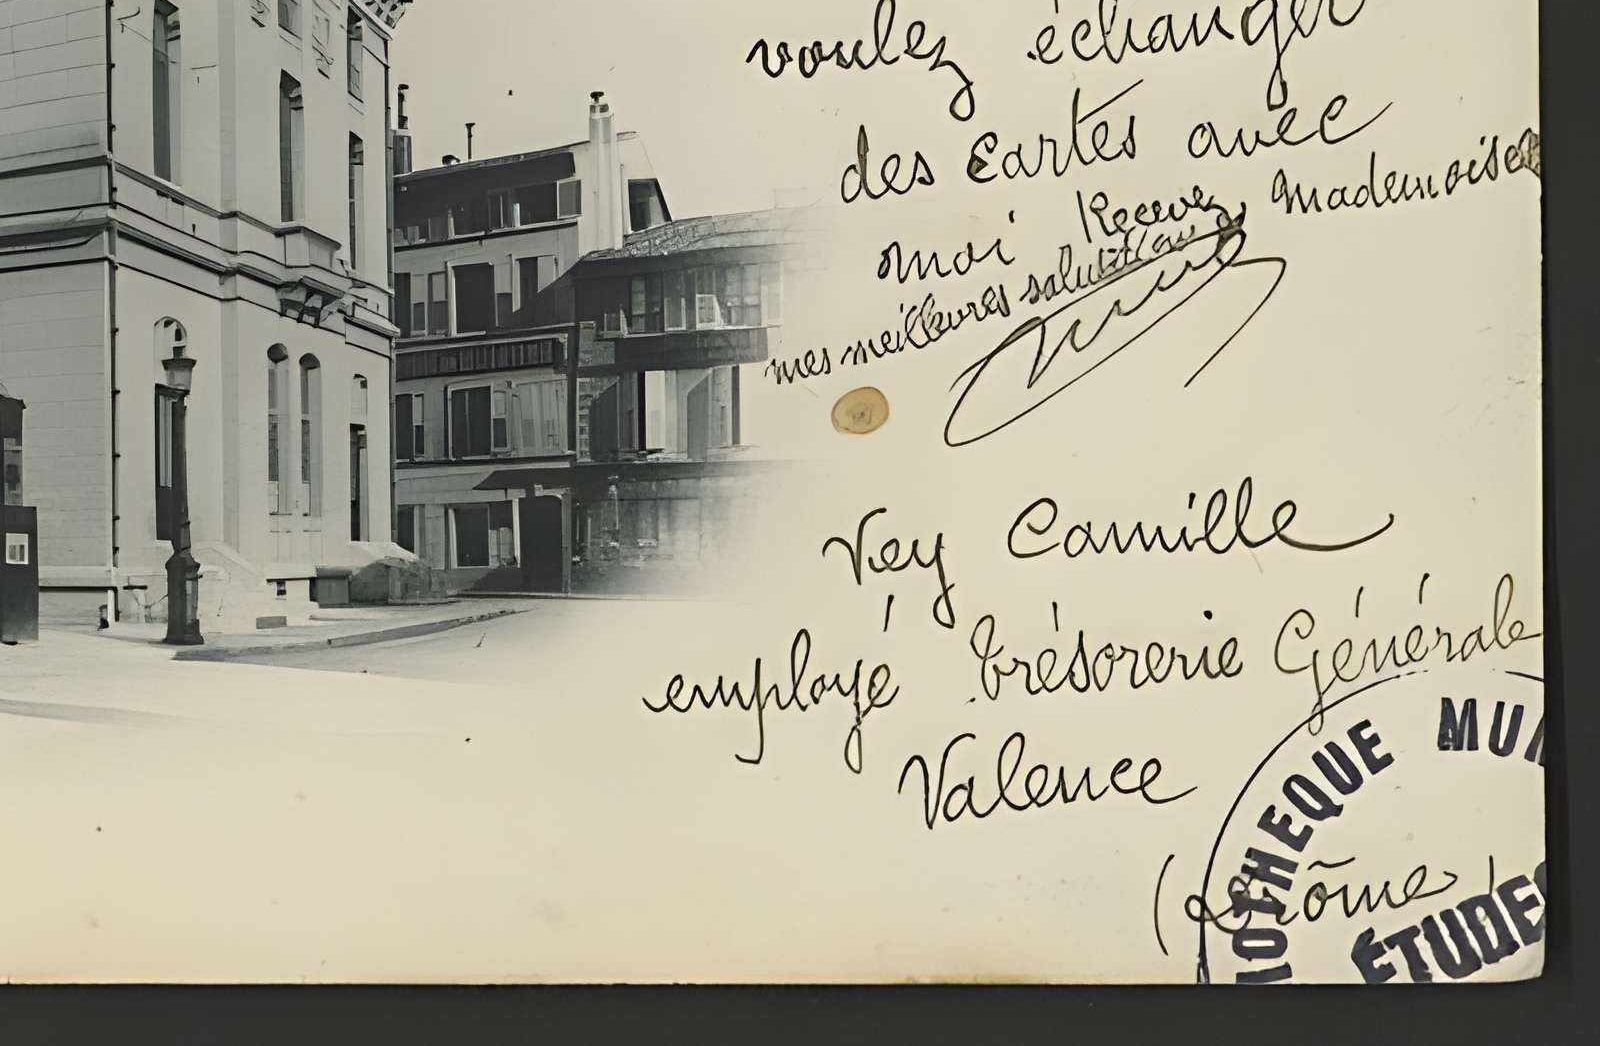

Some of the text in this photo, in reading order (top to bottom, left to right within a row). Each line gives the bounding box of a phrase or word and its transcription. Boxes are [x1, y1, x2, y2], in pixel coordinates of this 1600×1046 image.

[840, 124, 935, 204] des
[900, 732, 1197, 830] Valence
[1351, 861, 1546, 984] ÉTUDE
